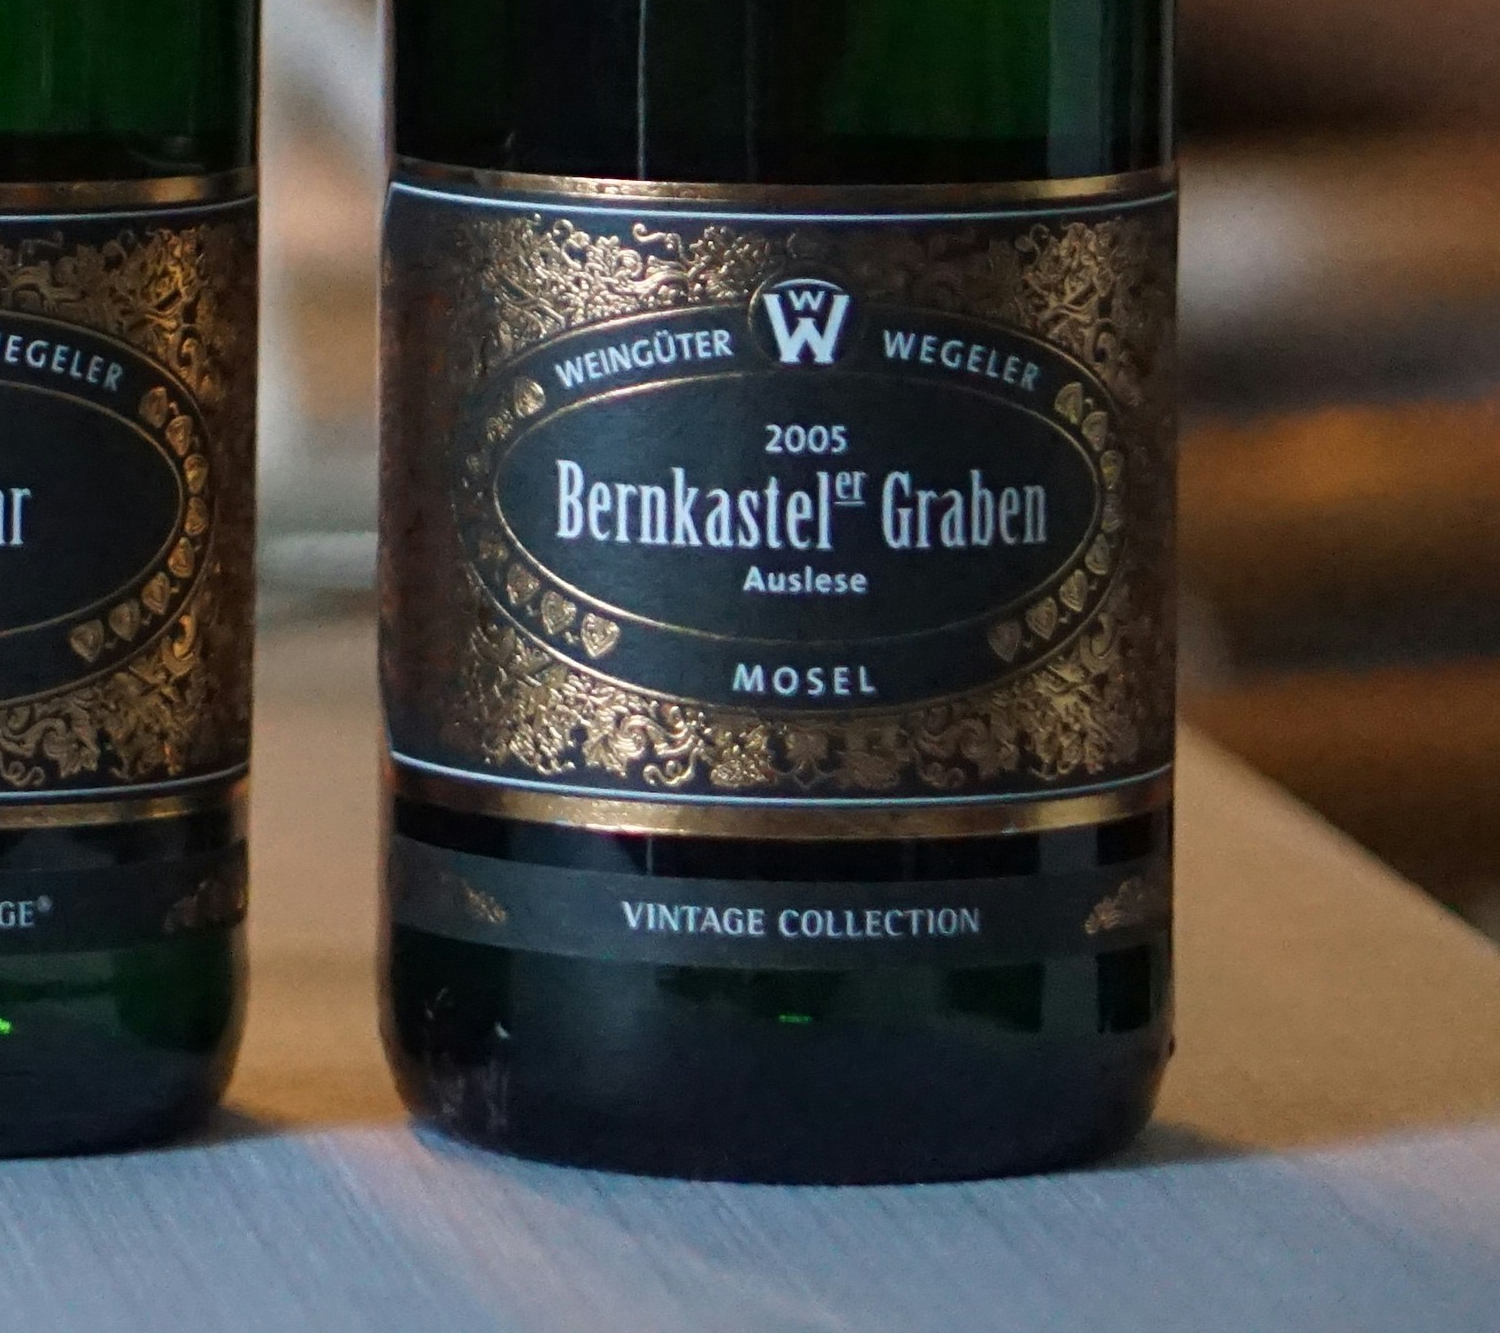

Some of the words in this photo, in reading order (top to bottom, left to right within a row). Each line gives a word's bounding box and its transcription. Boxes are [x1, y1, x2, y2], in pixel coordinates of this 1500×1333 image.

[555, 328, 735, 391] WEINGÜTER
[882, 329, 1043, 393] WEGELER
[764, 424, 848, 456] 2005
[880, 468, 1049, 548] Graben
[742, 564, 869, 595] Auslese
[731, 662, 878, 696] MOSEL
[621, 900, 765, 937] VINTAGE
[777, 904, 981, 937] COLLECTION
